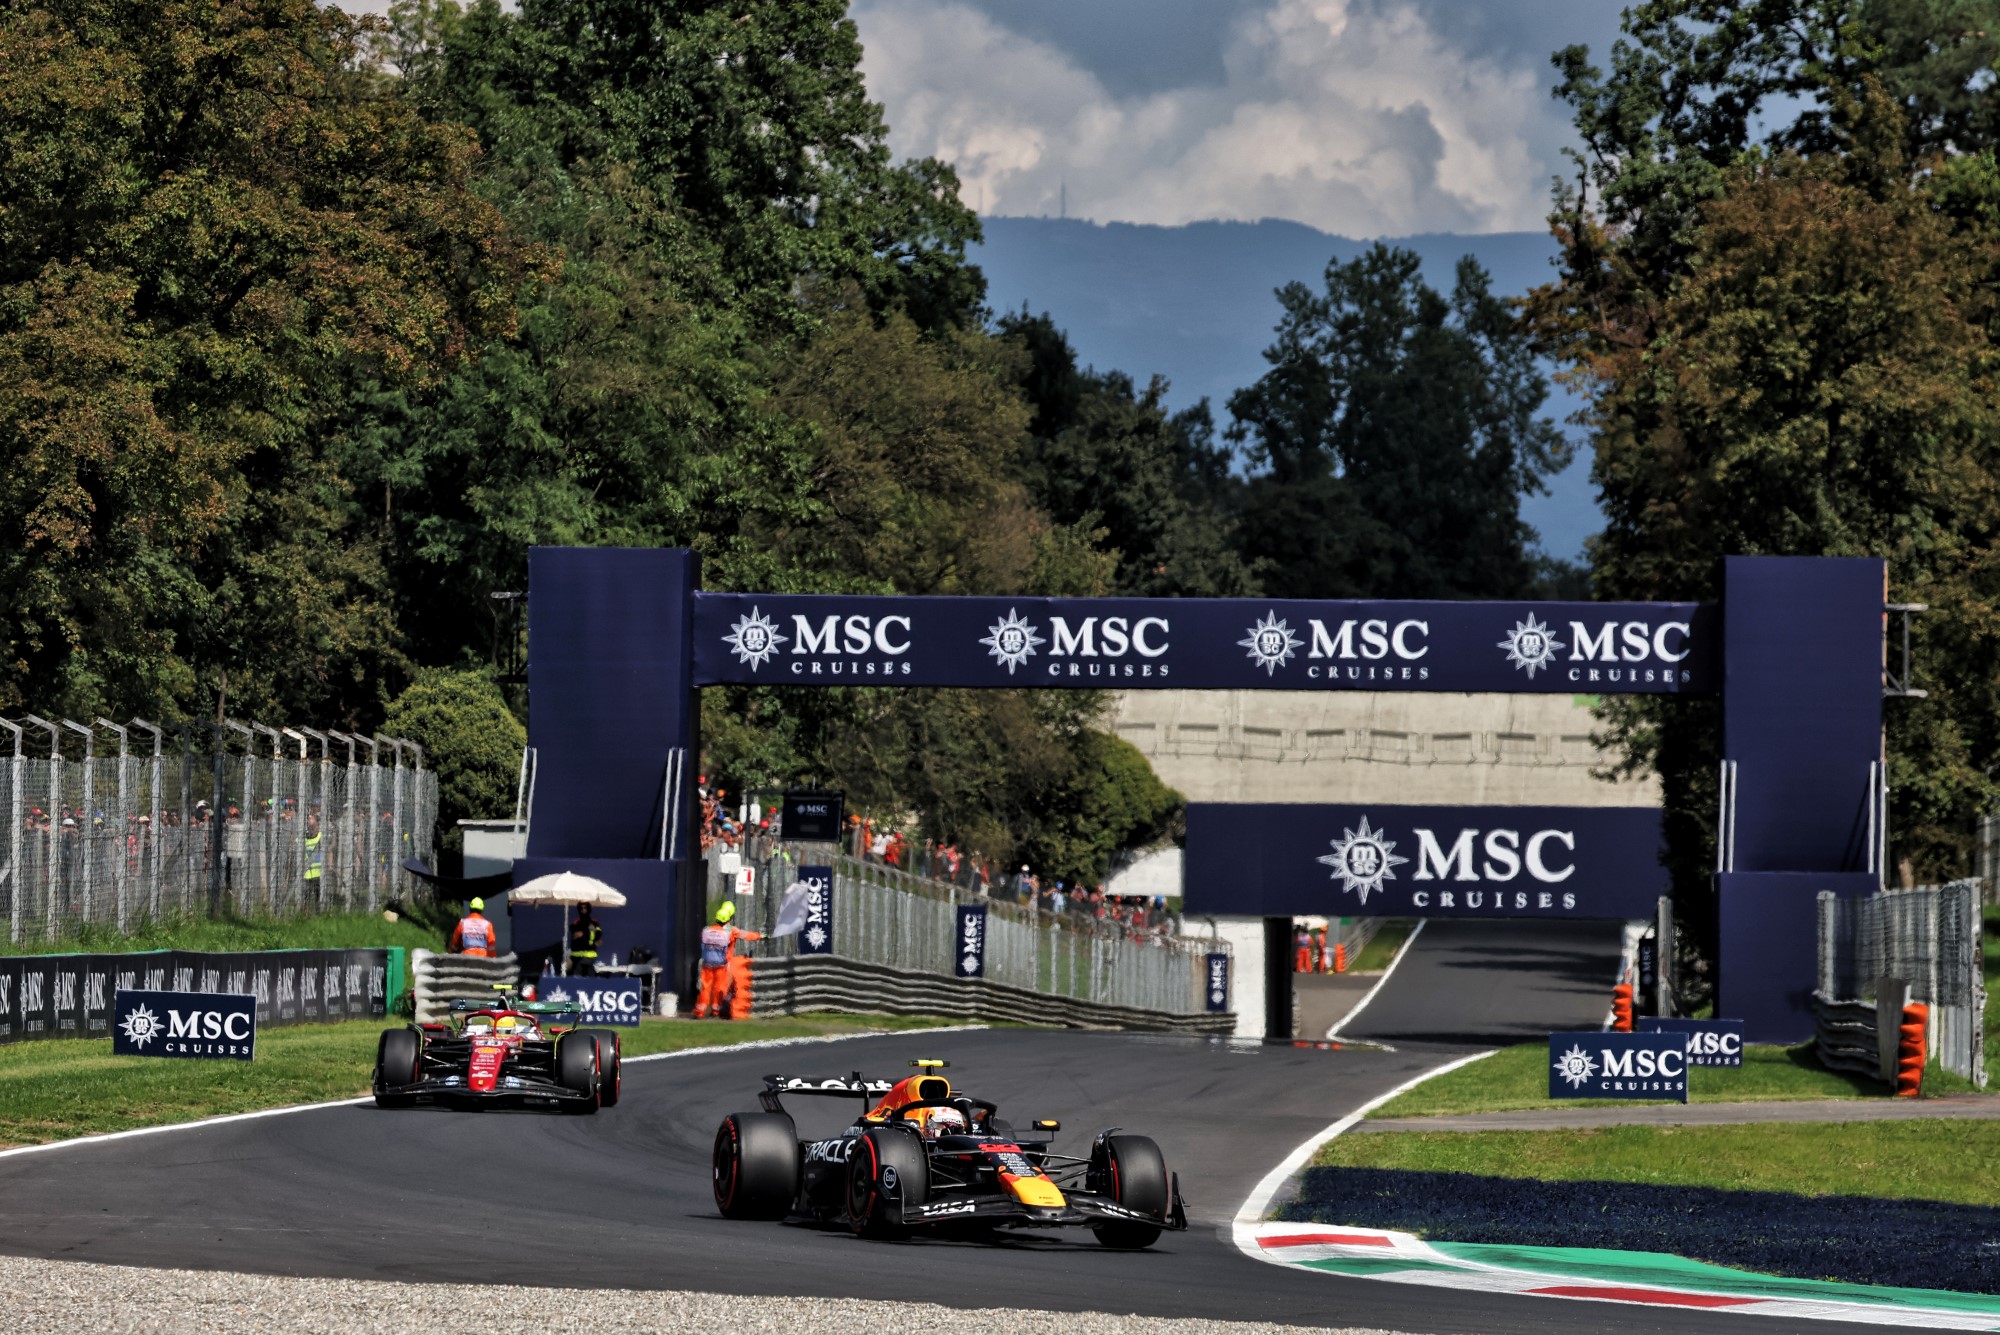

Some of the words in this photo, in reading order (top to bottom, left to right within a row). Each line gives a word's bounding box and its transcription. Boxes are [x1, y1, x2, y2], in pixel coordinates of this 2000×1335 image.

[790, 614, 911, 655] MSC
[1048, 616, 1170, 657] MSC
[1307, 619, 1429, 660] MSC
[1568, 620, 1690, 663] MSC
[791, 661, 911, 675] CRUISES
[1048, 663, 1169, 677] CRUISES
[1307, 665, 1429, 680] CRUISES
[1567, 667, 1690, 683] CRUISES
[1413, 828, 1576, 883] MSC
[807, 876, 823, 924] MSC
[1412, 891, 1576, 910] CRUISES
[963, 913, 978, 954] MSC
[27, 971, 44, 1011] MSC
[60, 971, 76, 1011] MSC
[90, 972, 106, 1011] MSC
[576, 989, 638, 1013] MSC
[166, 1009, 250, 1041] MSC
[165, 1043, 250, 1055] CRUISES
[1600, 1048, 1683, 1078] MSC
[1600, 1081, 1684, 1091] CRUISES
